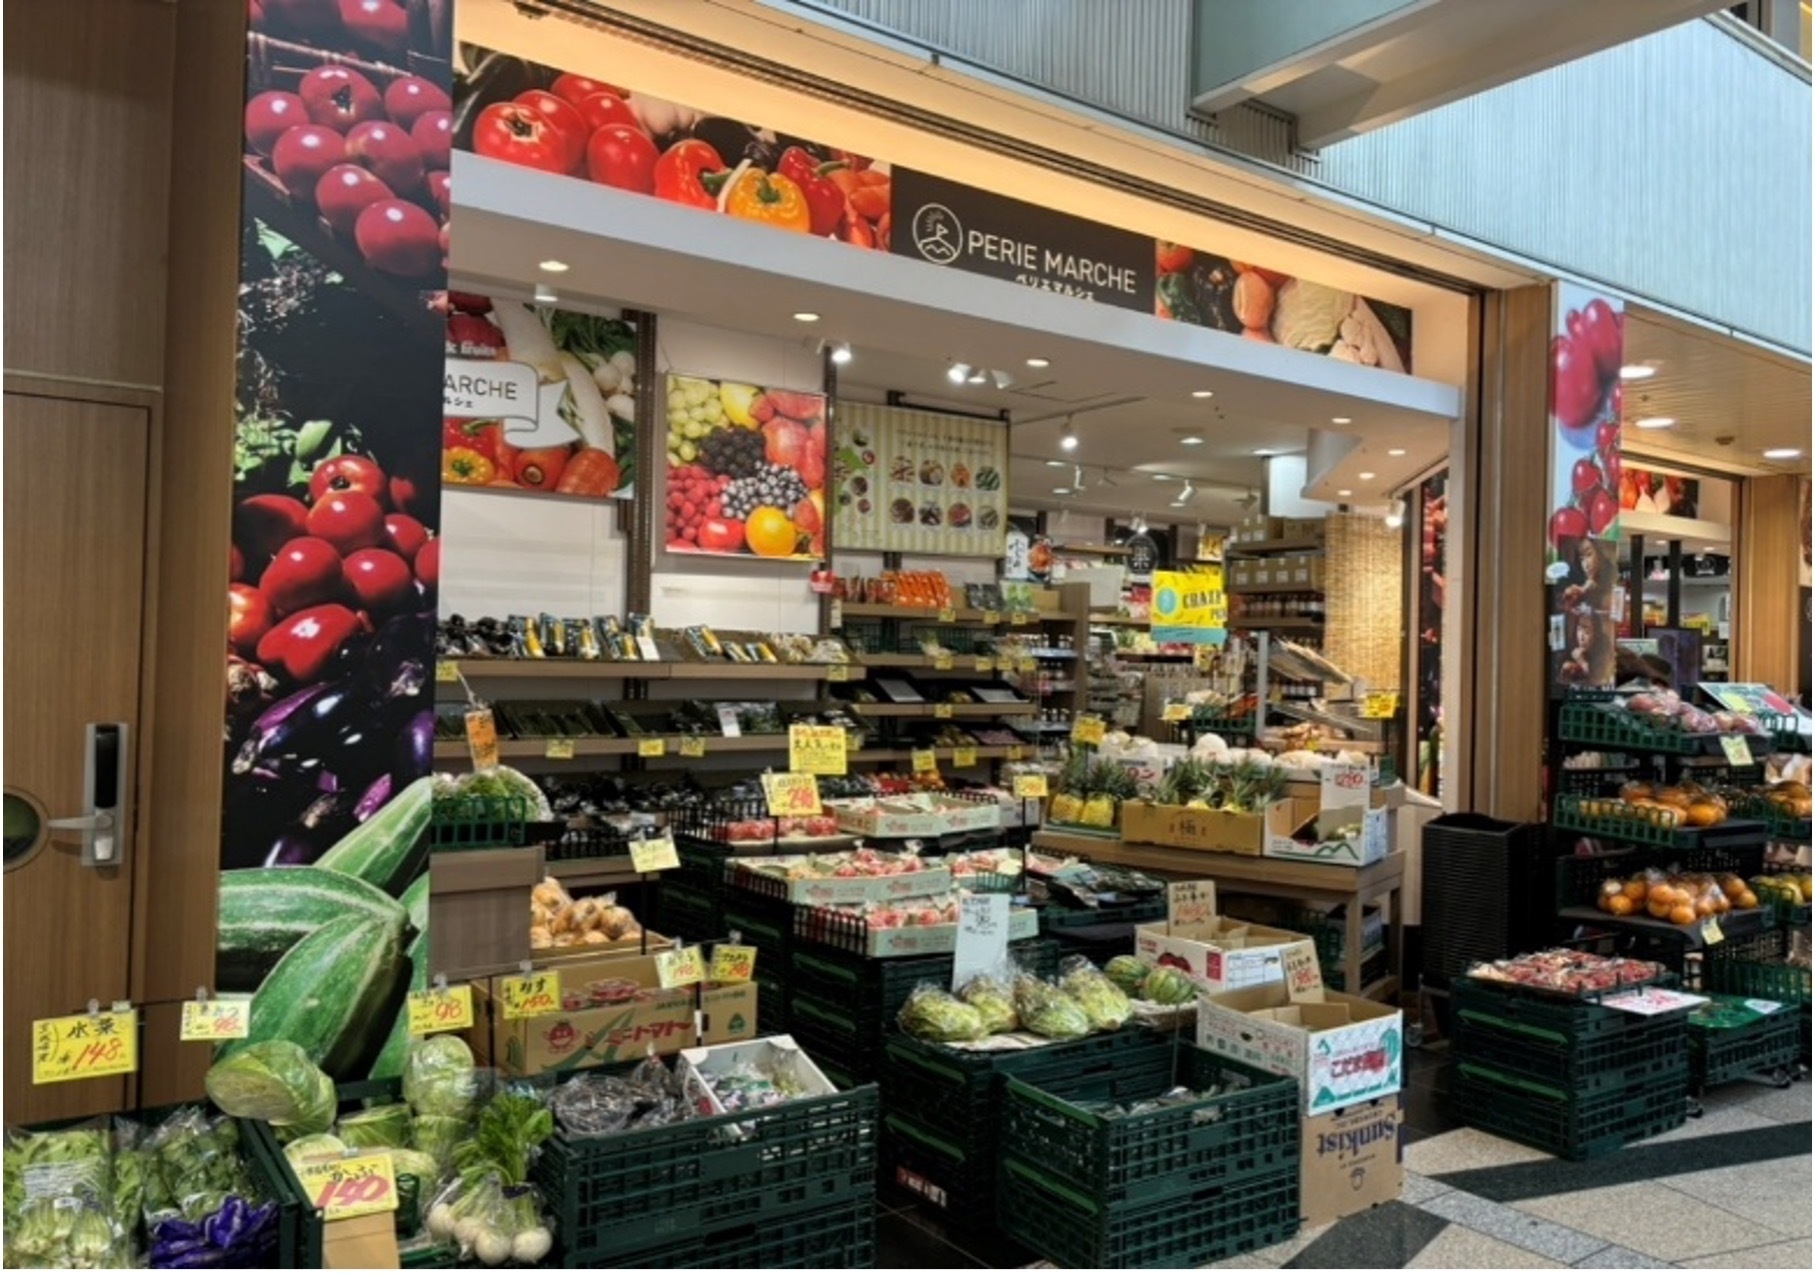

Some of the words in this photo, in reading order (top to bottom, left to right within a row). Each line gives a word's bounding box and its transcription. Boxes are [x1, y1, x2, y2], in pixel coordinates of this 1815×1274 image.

[968, 230, 1038, 270] PERIE
[1044, 249, 1137, 294] MARCHE
[445, 374, 518, 401] ARCHE
[72, 1037, 122, 1072] 148
[1316, 1110, 1396, 1160] Sunkist
